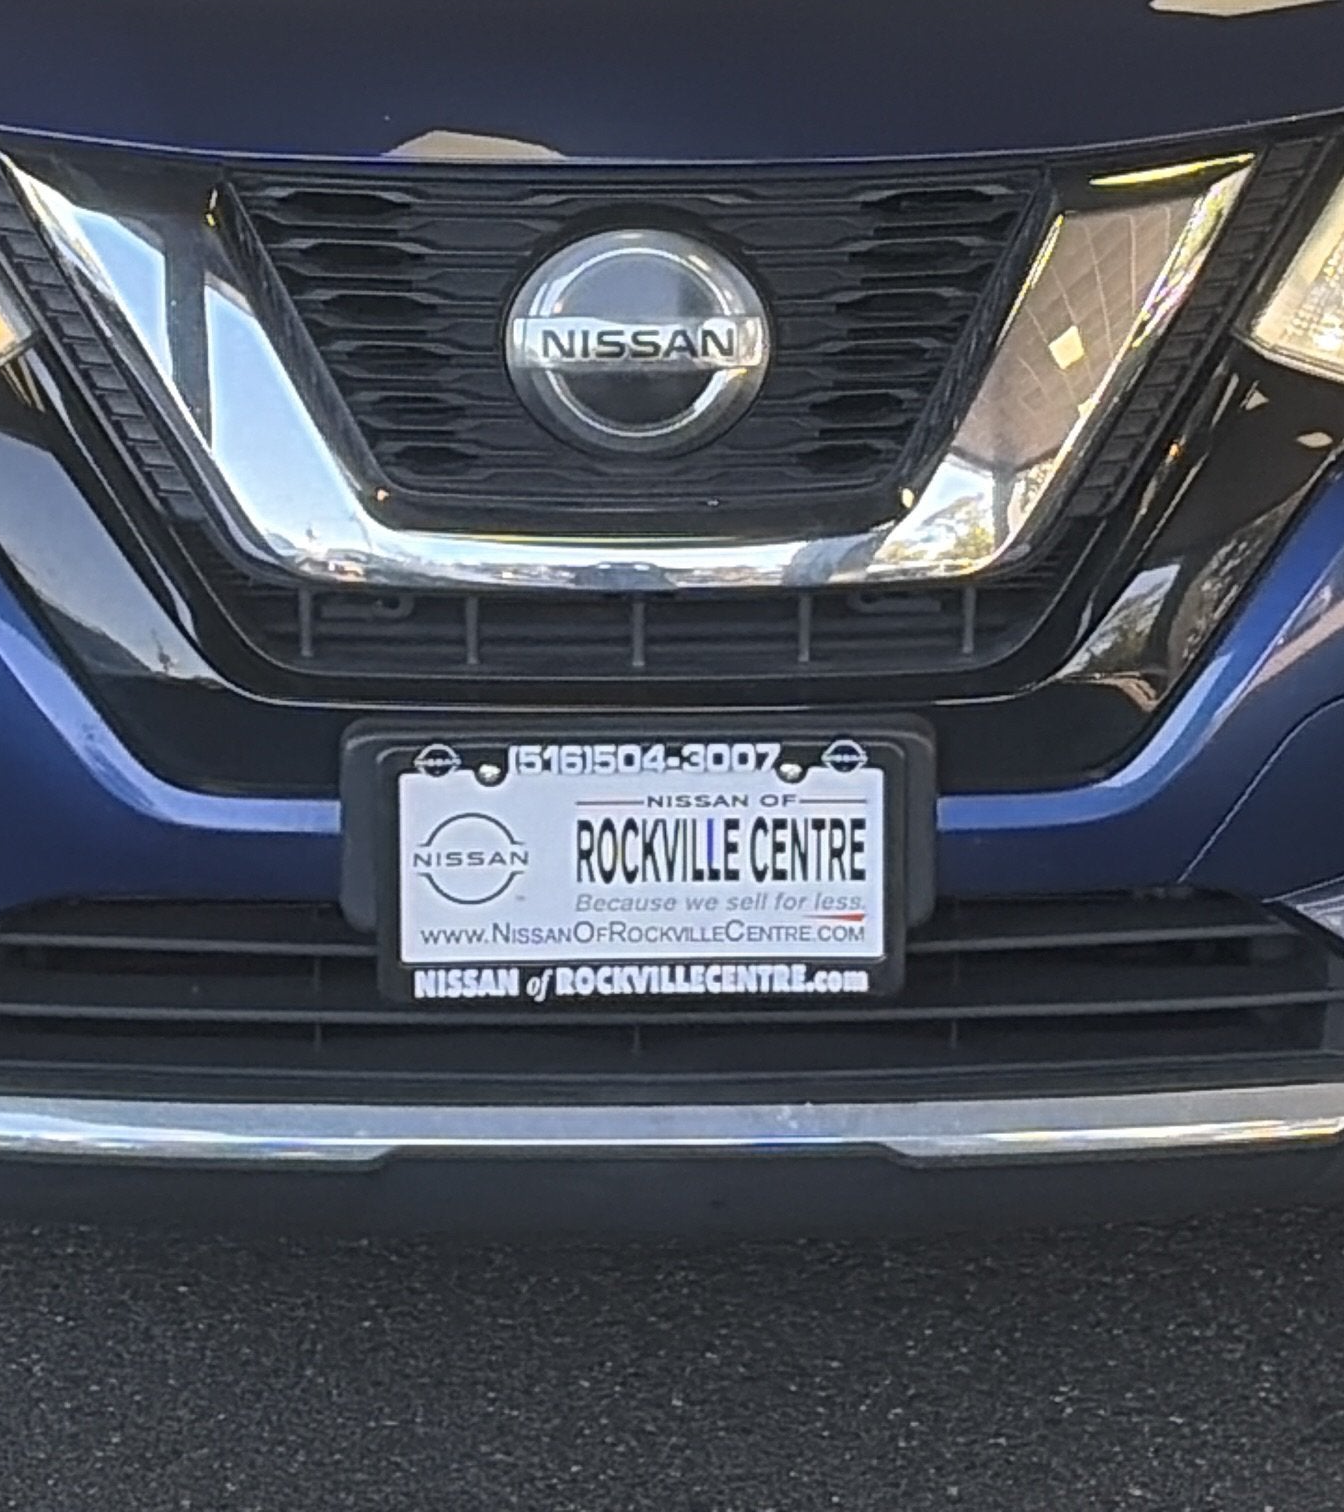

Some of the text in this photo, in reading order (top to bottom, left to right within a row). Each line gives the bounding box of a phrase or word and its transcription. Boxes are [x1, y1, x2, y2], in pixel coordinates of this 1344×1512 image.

[541, 328, 736, 360] NISSAN
[508, 742, 781, 775] (516)504-3007
[646, 793, 797, 809] NISSAN OF
[413, 850, 529, 868] NISSAN
[576, 816, 866, 884] ROCKVILLE CENTRE
[575, 891, 866, 913] Because we sell for less.
[414, 963, 869, 1002] NISSAN of ROCKVILLECENTRE.com
